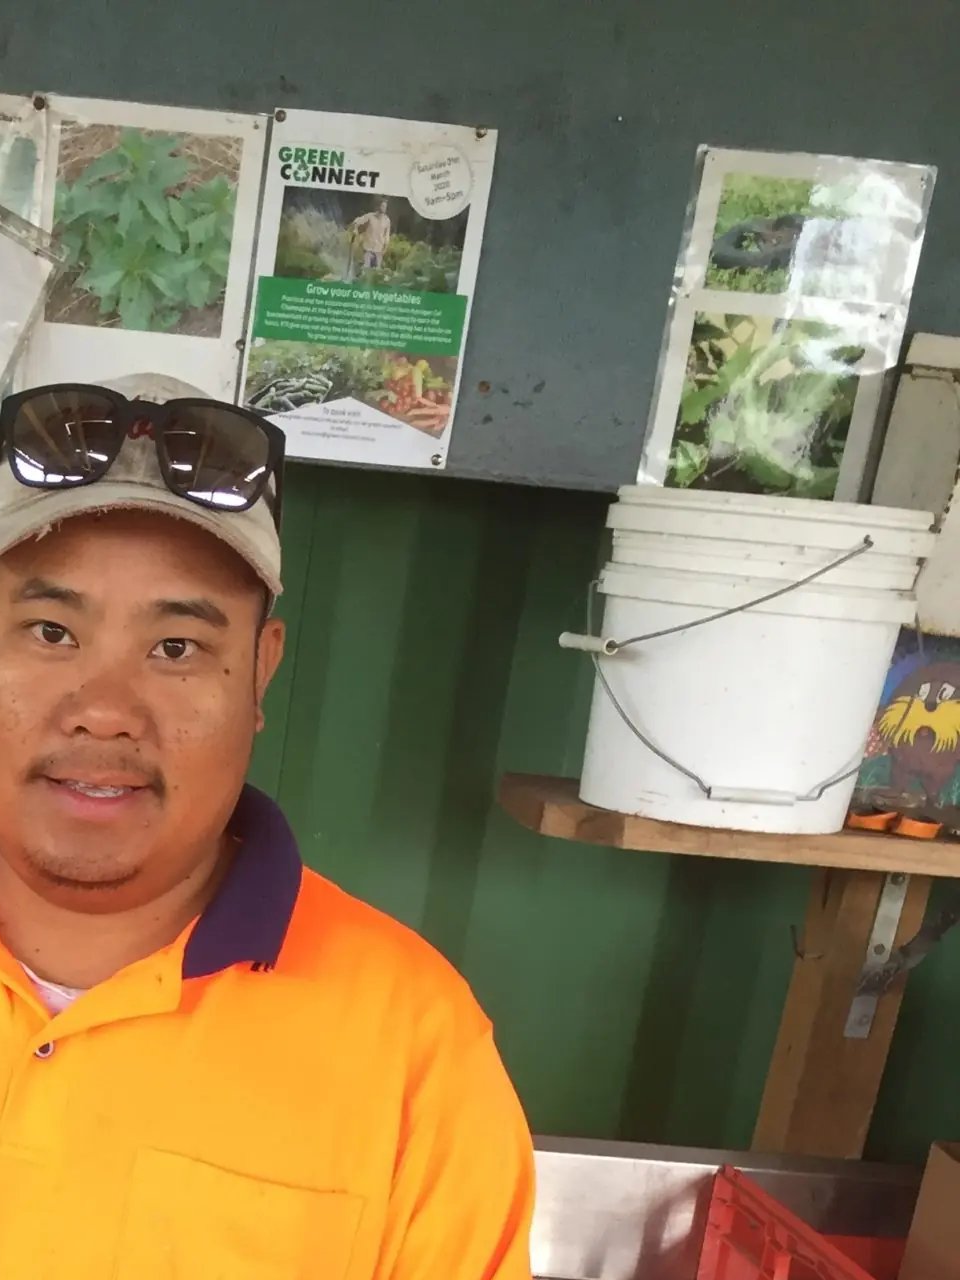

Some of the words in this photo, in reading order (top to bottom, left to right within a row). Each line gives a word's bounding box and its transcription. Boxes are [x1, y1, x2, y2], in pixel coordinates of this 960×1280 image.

[279, 147, 344, 166] GREEN
[306, 284, 329, 295] Grow
[331, 288, 351, 298] your
[353, 290, 370, 299] own
[372, 290, 421, 304] Vegetables
